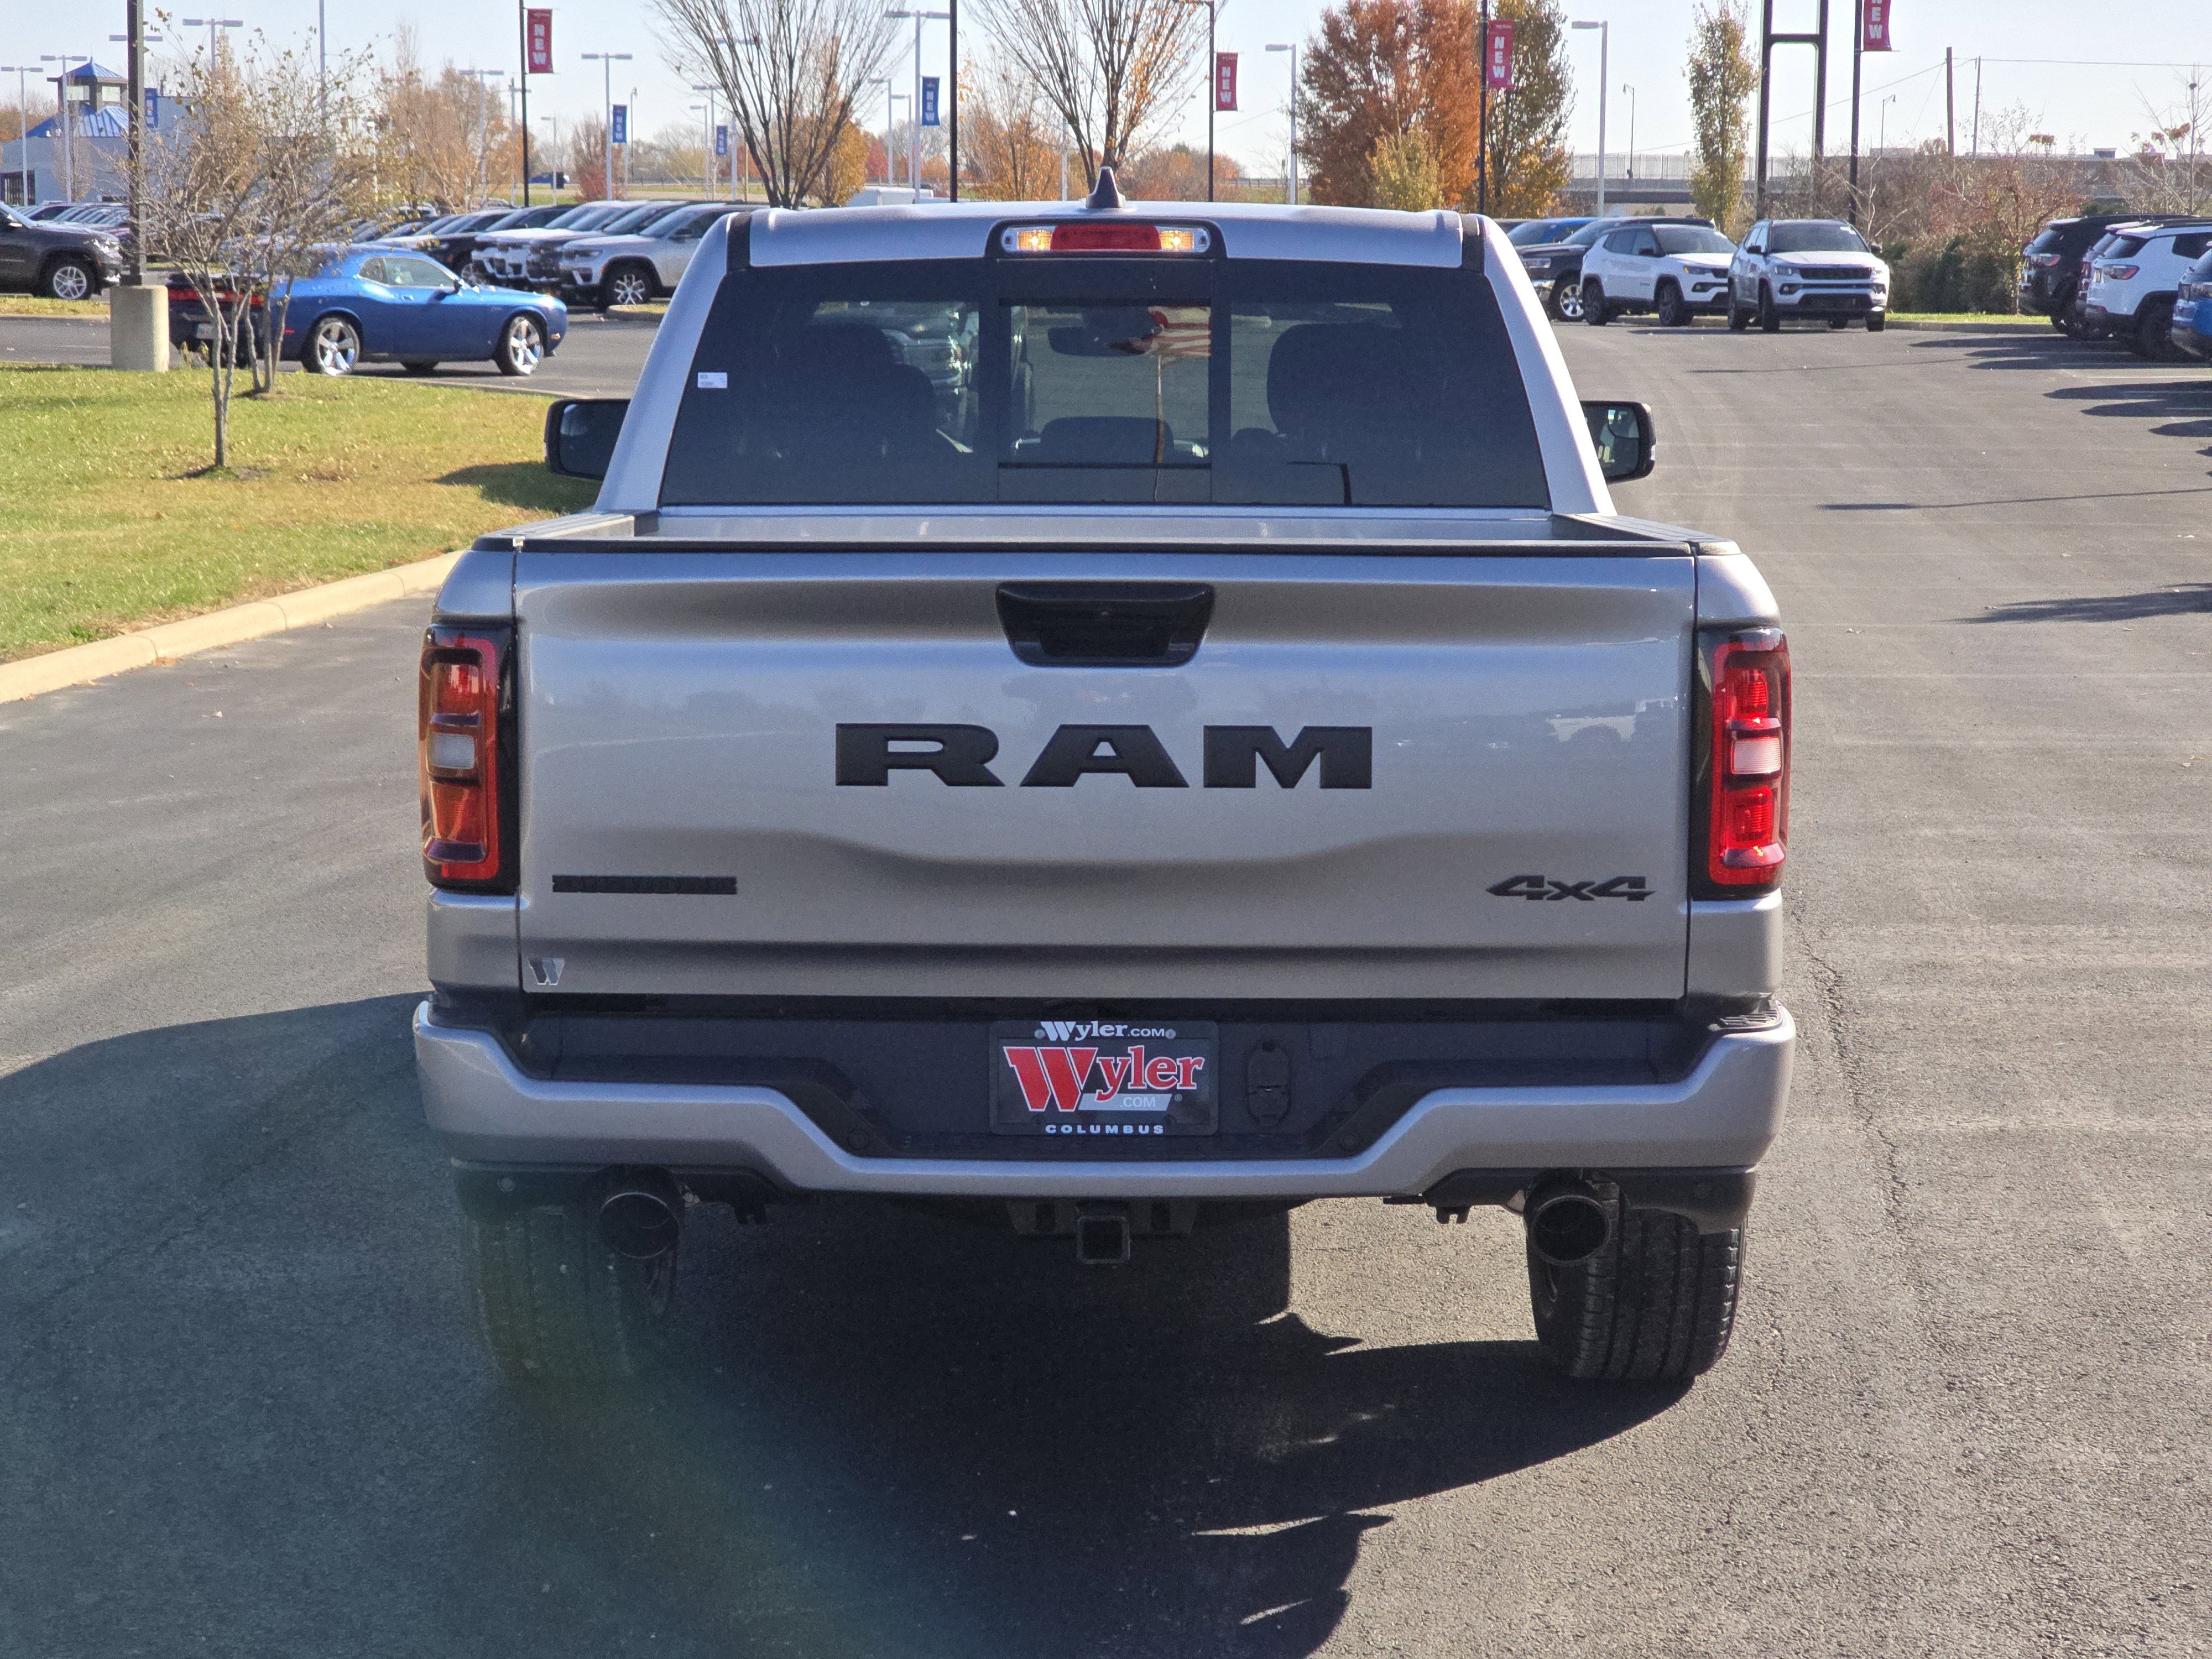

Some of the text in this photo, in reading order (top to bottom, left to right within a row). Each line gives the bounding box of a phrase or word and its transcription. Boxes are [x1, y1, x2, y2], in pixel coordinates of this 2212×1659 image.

[533, 24, 546, 65] NEW
[1493, 36, 1505, 78] NEW
[1220, 66, 1232, 103] NEW
[925, 90, 935, 122] NEW
[836, 723, 1372, 789] RAM
[1485, 875, 1656, 901] 4x4
[1003, 1045, 1205, 1112] Wyler
[1045, 1124, 1164, 1134] COLUMBUS
